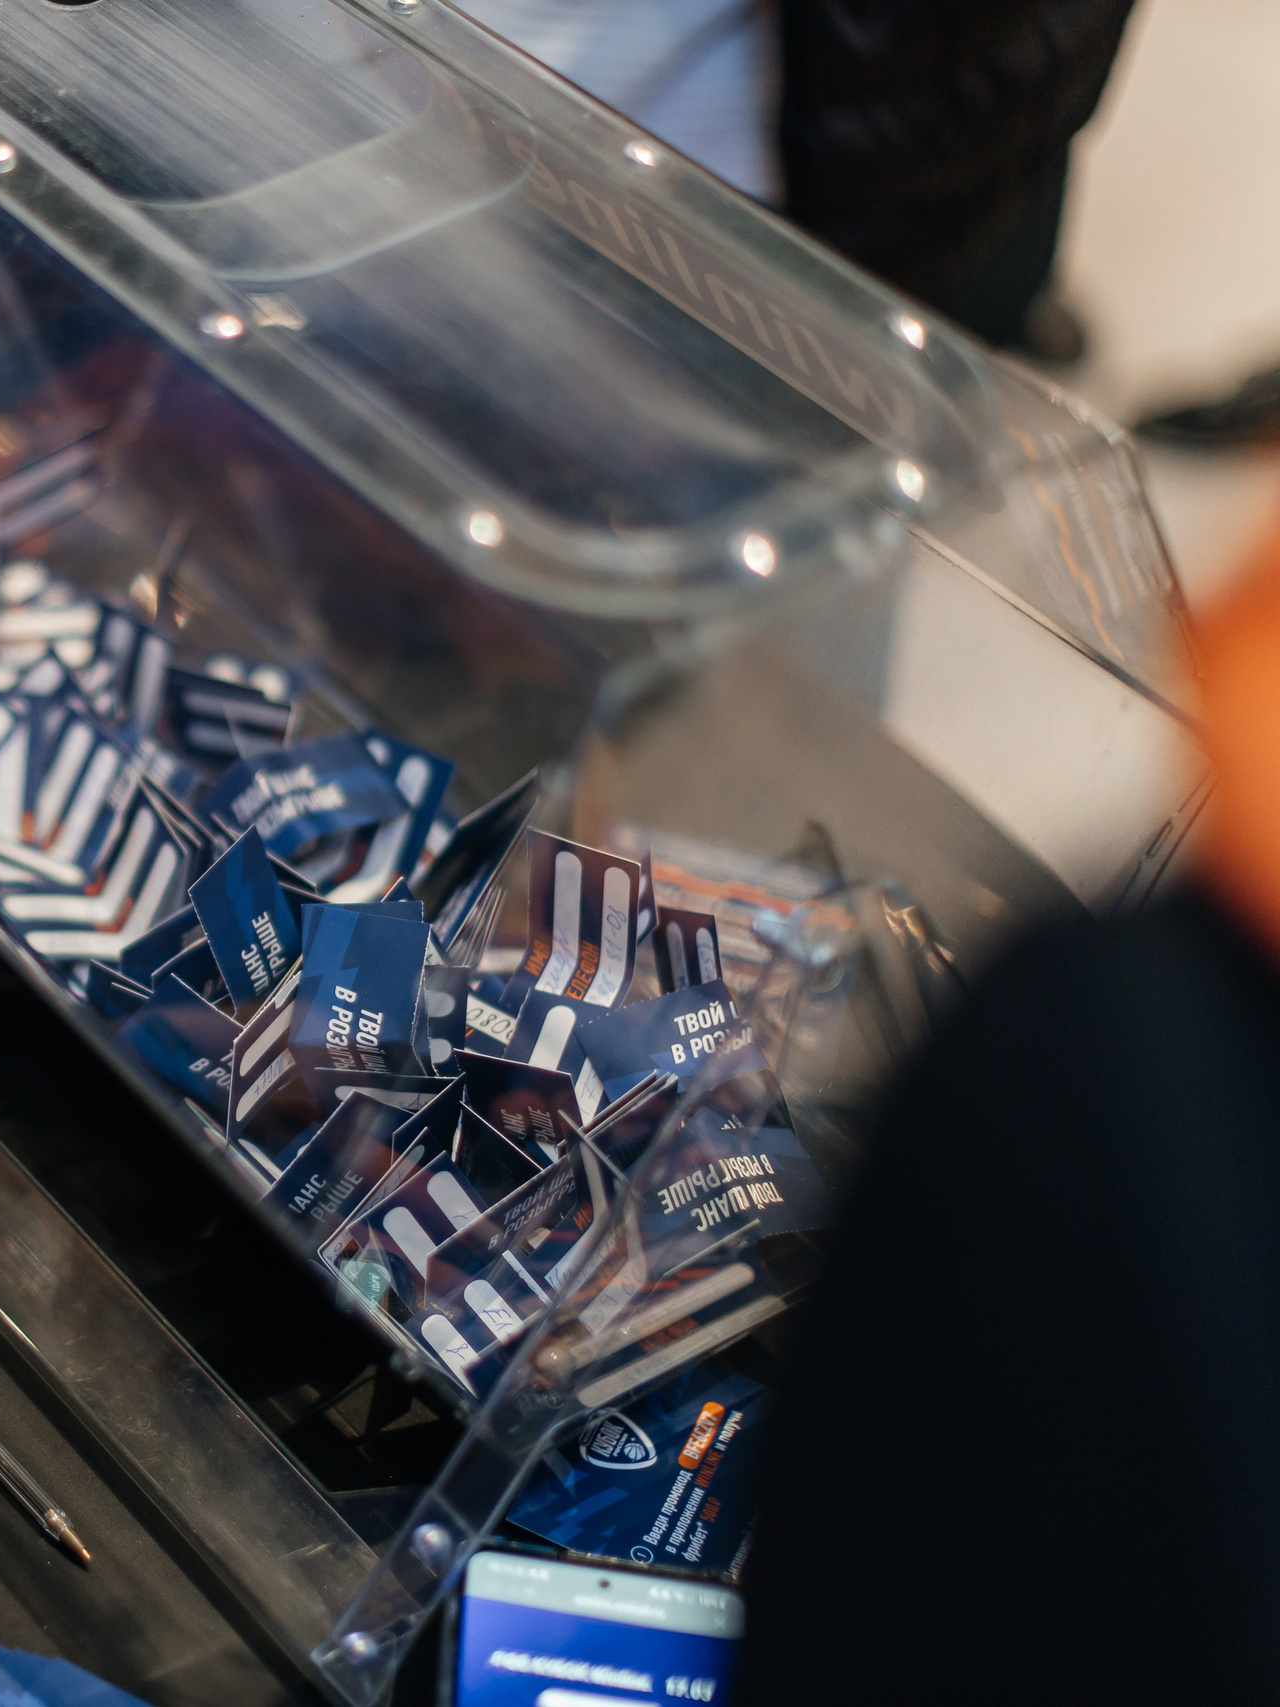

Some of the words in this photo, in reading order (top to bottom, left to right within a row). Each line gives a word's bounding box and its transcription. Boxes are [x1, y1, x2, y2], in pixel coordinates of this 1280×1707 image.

[524, 939, 550, 976] ИМЯ
[564, 940, 599, 1000] ЕЛЕФОН
[334, 985, 357, 1003] В
[356, 1009, 386, 1054] ТВОЙ
[673, 1000, 726, 1036] ТВОЙ
[670, 1044, 686, 1064] В
[188, 1058, 204, 1072] В
[204, 1063, 229, 1089] РО
[501, 1109, 526, 1140] АНС
[761, 1153, 775, 1175] В
[657, 1155, 762, 1214] РОЗЫГРЫШЕ
[749, 1180, 784, 1210] ТВОЙ
[504, 1184, 545, 1225] ТВОЙ
[690, 1187, 749, 1232] ШАНС
[488, 1233, 499, 1251] В
[590, 1420, 624, 1458] КУБОК
[718, 1410, 744, 1444] получи
[714, 1441, 726, 1451] и
[694, 1449, 724, 1488] WINLINE
[642, 1515, 669, 1545] Введи
[661, 1469, 694, 1516] промокод
[670, 1487, 705, 1543] приложении
[665, 1544, 677, 1554] в
